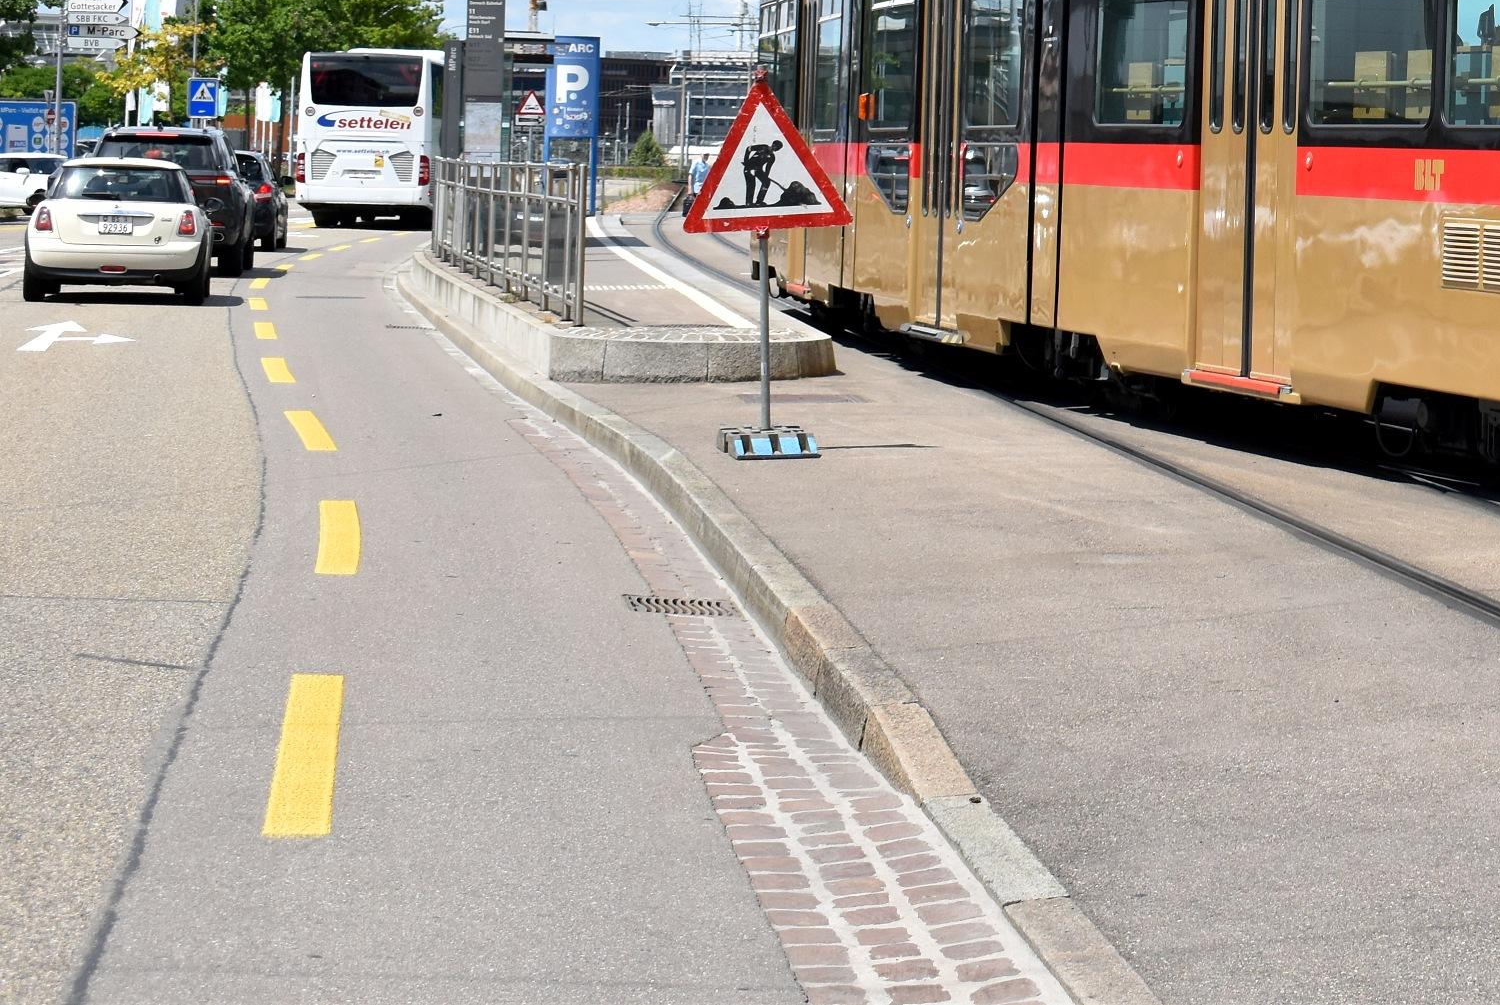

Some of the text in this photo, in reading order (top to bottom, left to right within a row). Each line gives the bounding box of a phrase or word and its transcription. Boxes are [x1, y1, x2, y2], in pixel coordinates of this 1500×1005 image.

[86, 26, 125, 37] M-Parc
[84, 39, 99, 47] BVB
[568, 43, 594, 53] ARC
[556, 64, 589, 104] P
[1414, 159, 1445, 191] BLT
[103, 224, 127, 232] 92936
